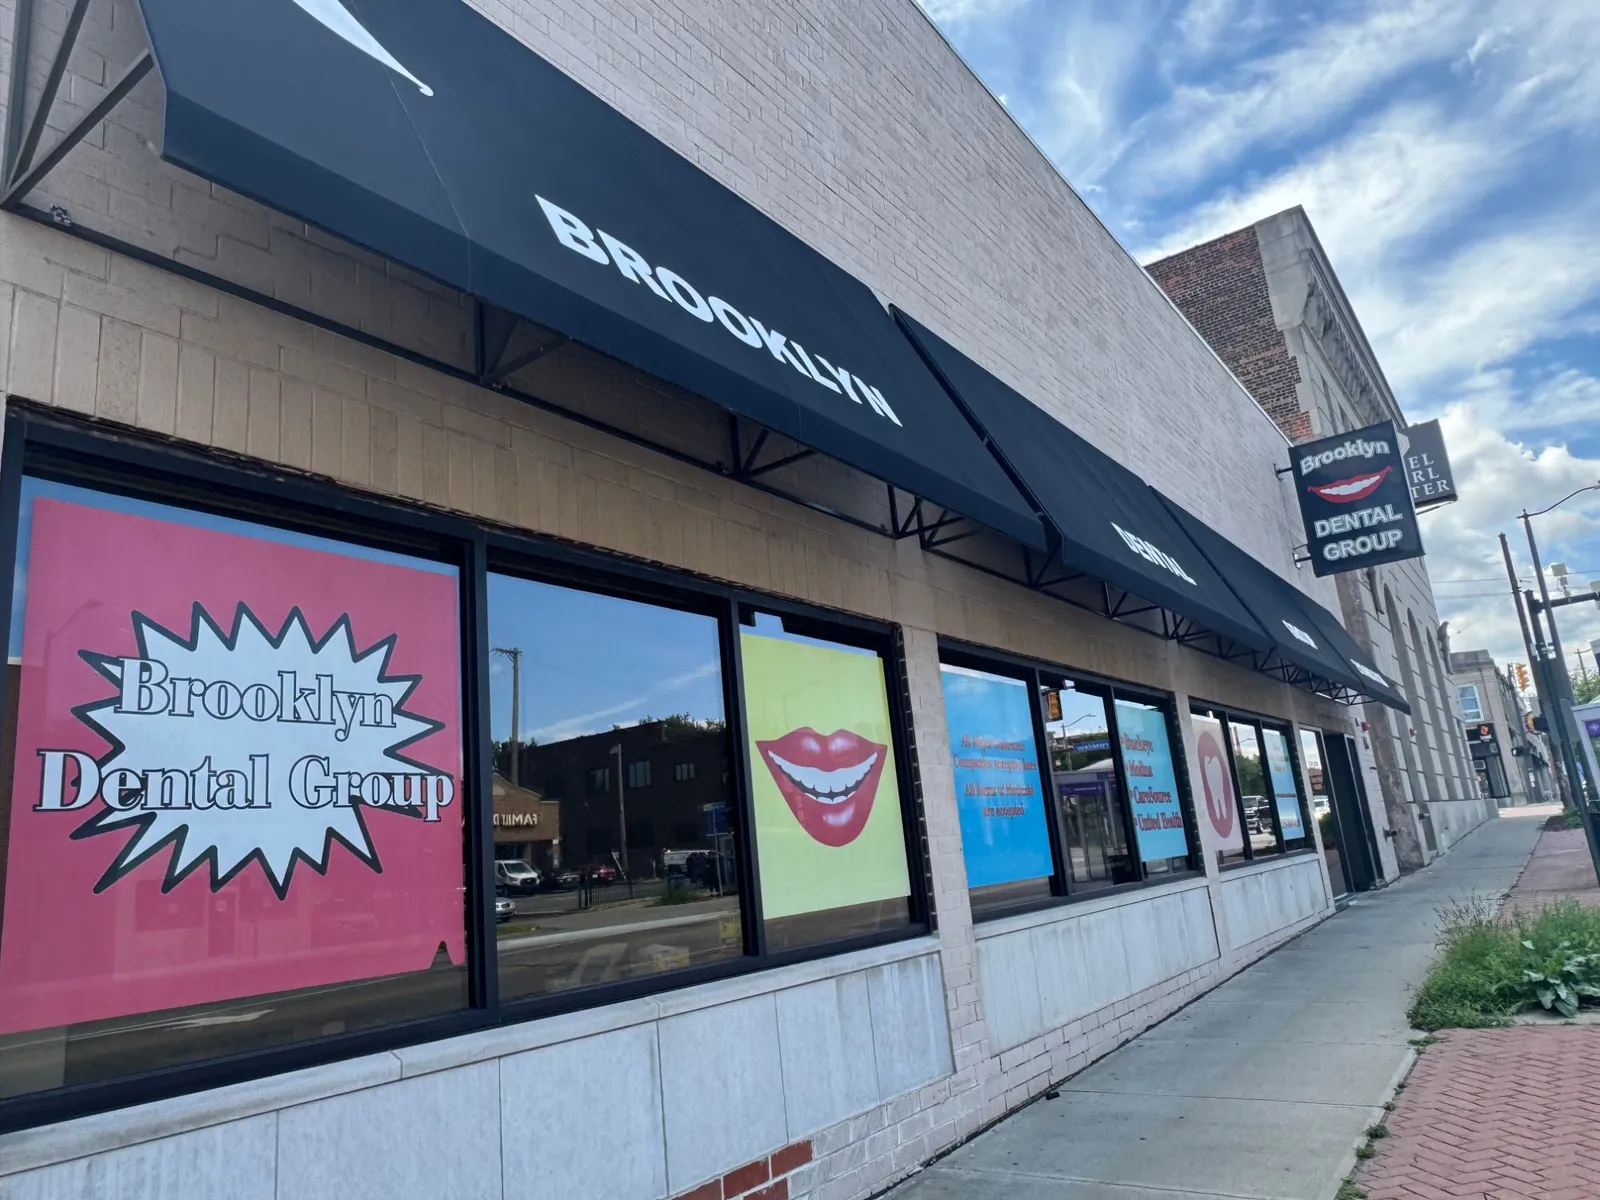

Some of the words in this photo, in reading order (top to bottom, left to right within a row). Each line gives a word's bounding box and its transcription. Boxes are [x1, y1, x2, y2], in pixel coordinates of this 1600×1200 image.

[535, 194, 903, 427] BROOKLYN
[1300, 439, 1391, 476] Brooklyn
[1314, 504, 1403, 538] DENTAL
[1322, 529, 1403, 561] GROUP
[115, 656, 397, 742] Brooklyn
[33, 748, 272, 813] Dental
[288, 754, 454, 822] Group
